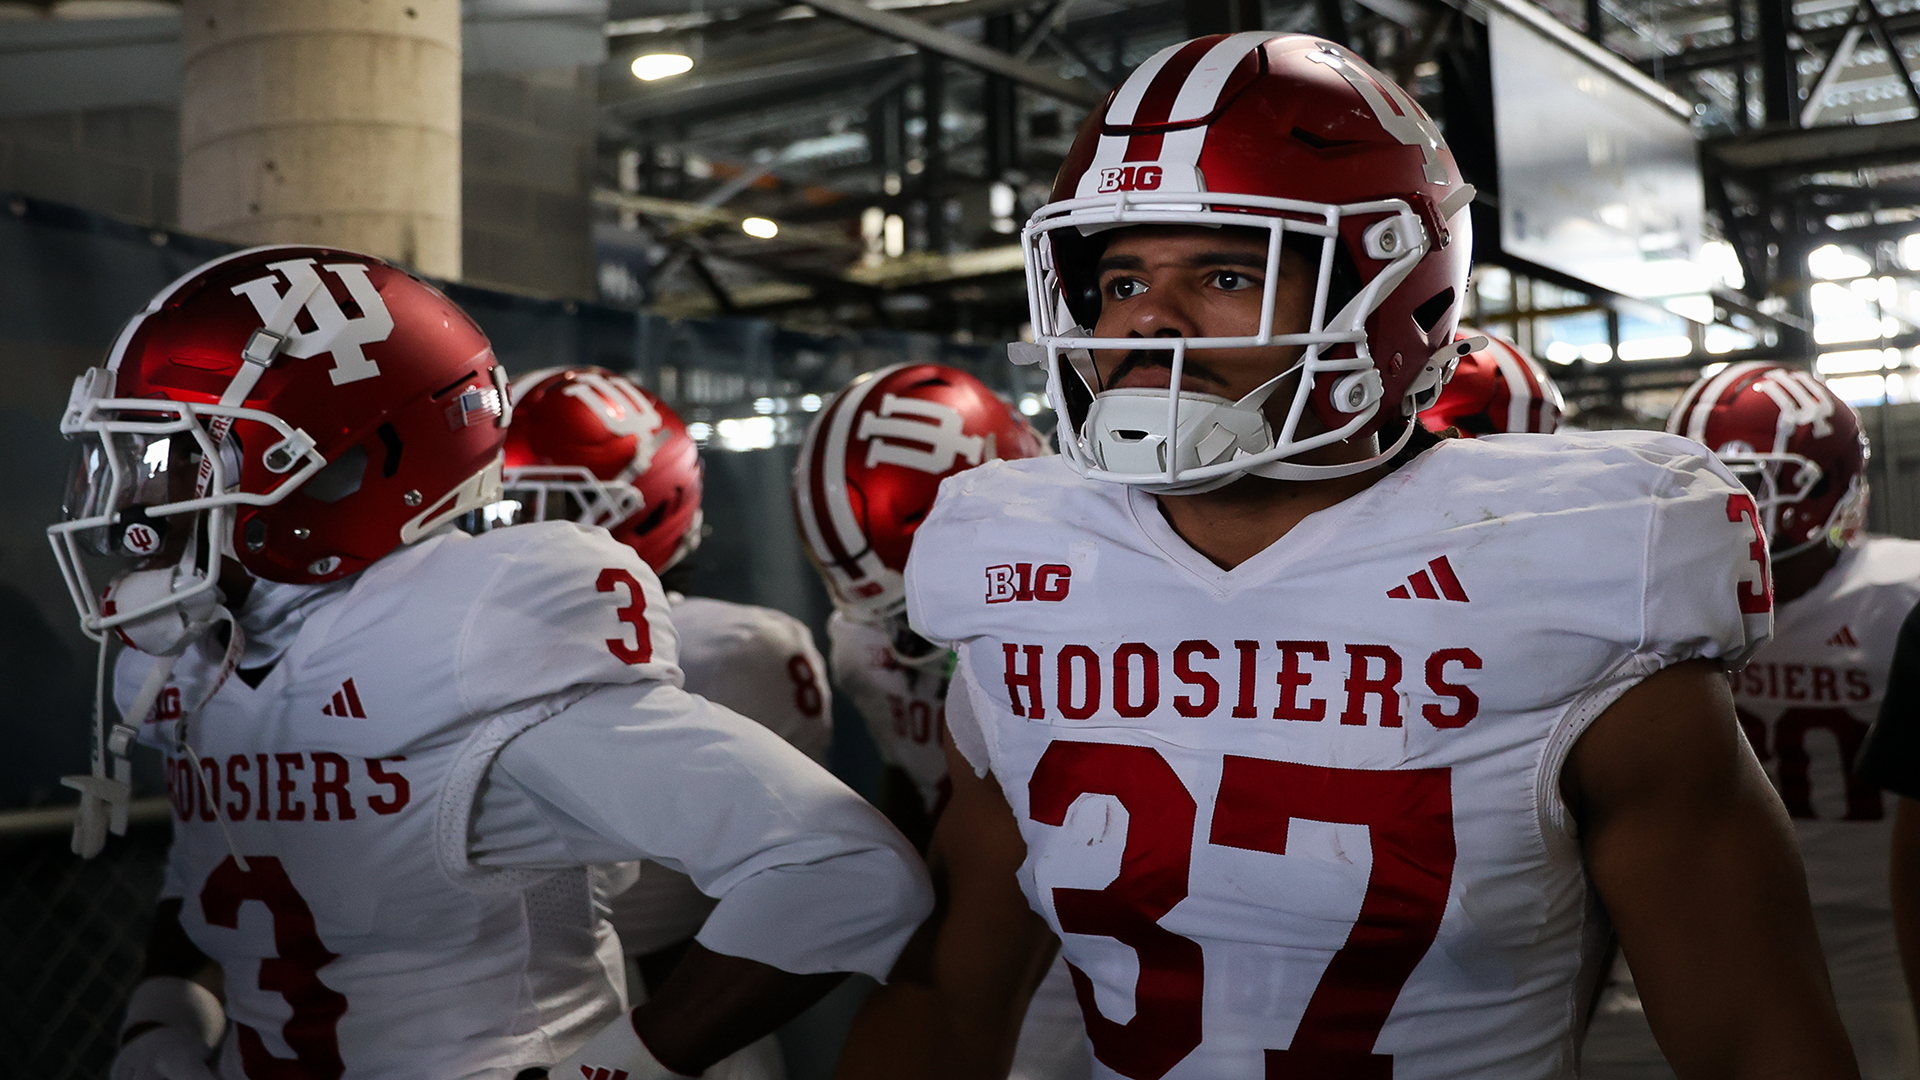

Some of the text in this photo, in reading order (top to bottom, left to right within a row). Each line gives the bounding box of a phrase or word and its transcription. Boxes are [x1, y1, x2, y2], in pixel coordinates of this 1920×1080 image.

[596, 568, 653, 666] 3
[786, 653, 822, 718] 8
[1002, 639, 1483, 729] HOOSIERS
[1028, 739, 1458, 1080] 37
[200, 855, 348, 1080] 3
